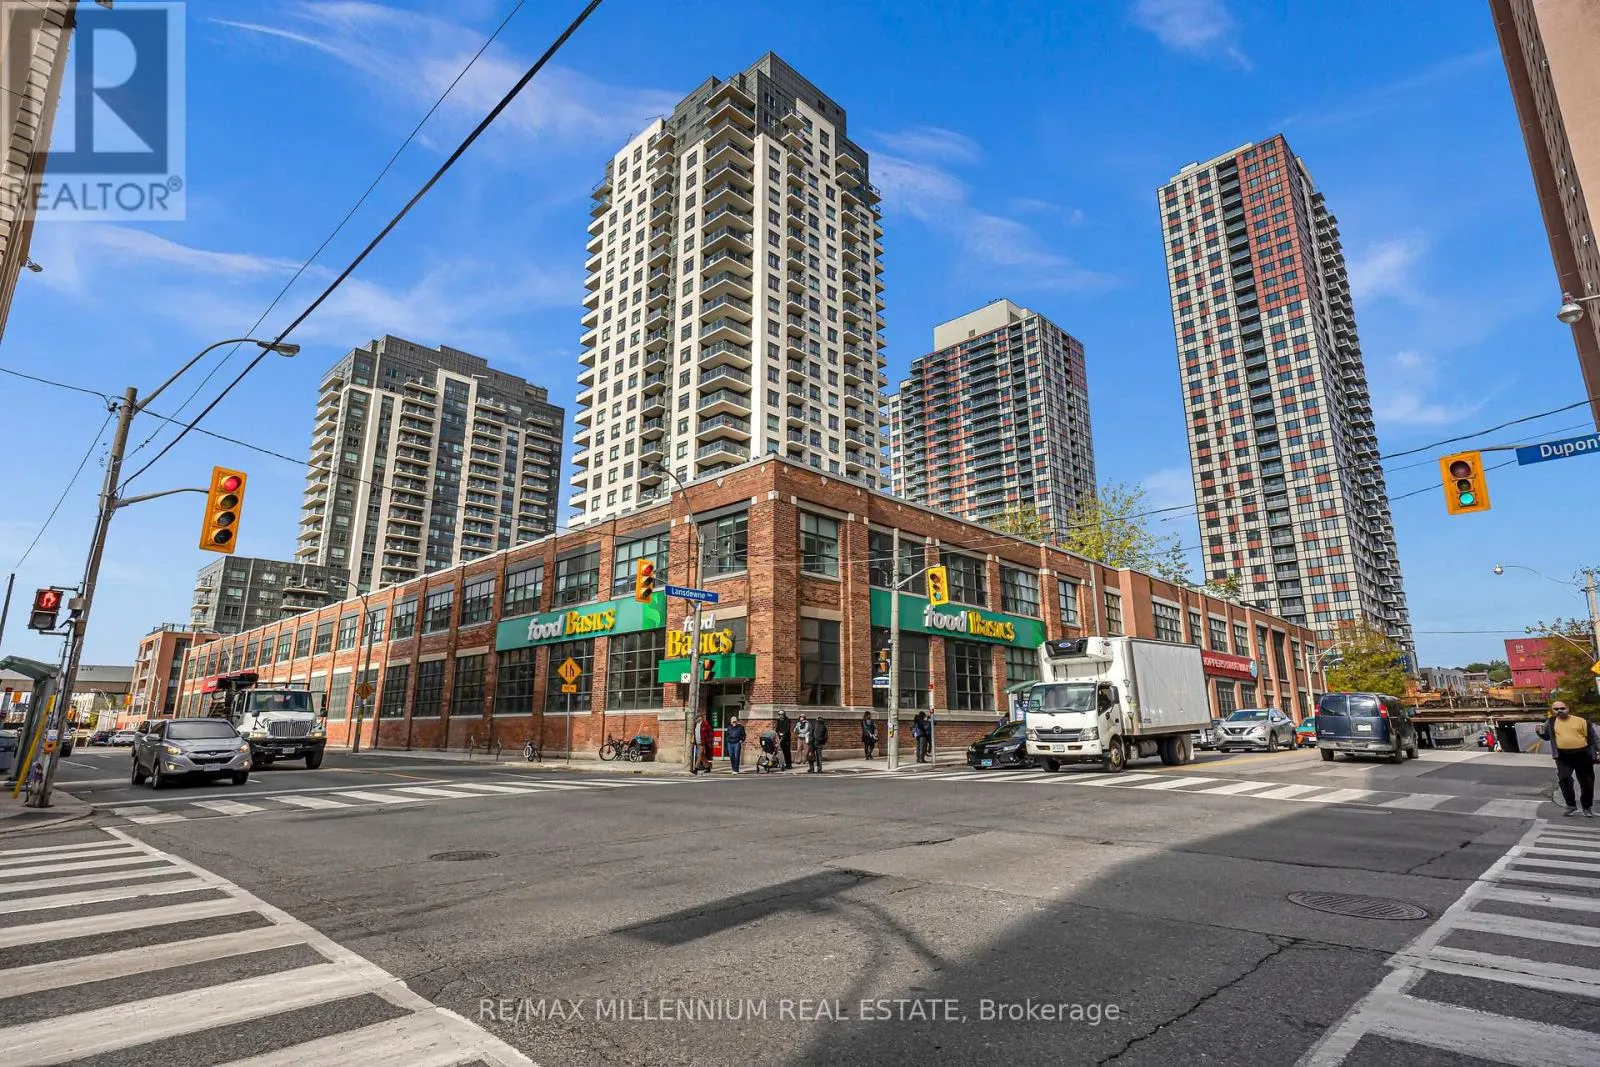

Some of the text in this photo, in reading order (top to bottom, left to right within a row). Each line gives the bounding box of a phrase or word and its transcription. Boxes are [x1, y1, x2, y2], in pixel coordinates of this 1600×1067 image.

[671, 587, 706, 599] Lansdowne
[528, 614, 564, 640] food
[923, 604, 967, 633] food
